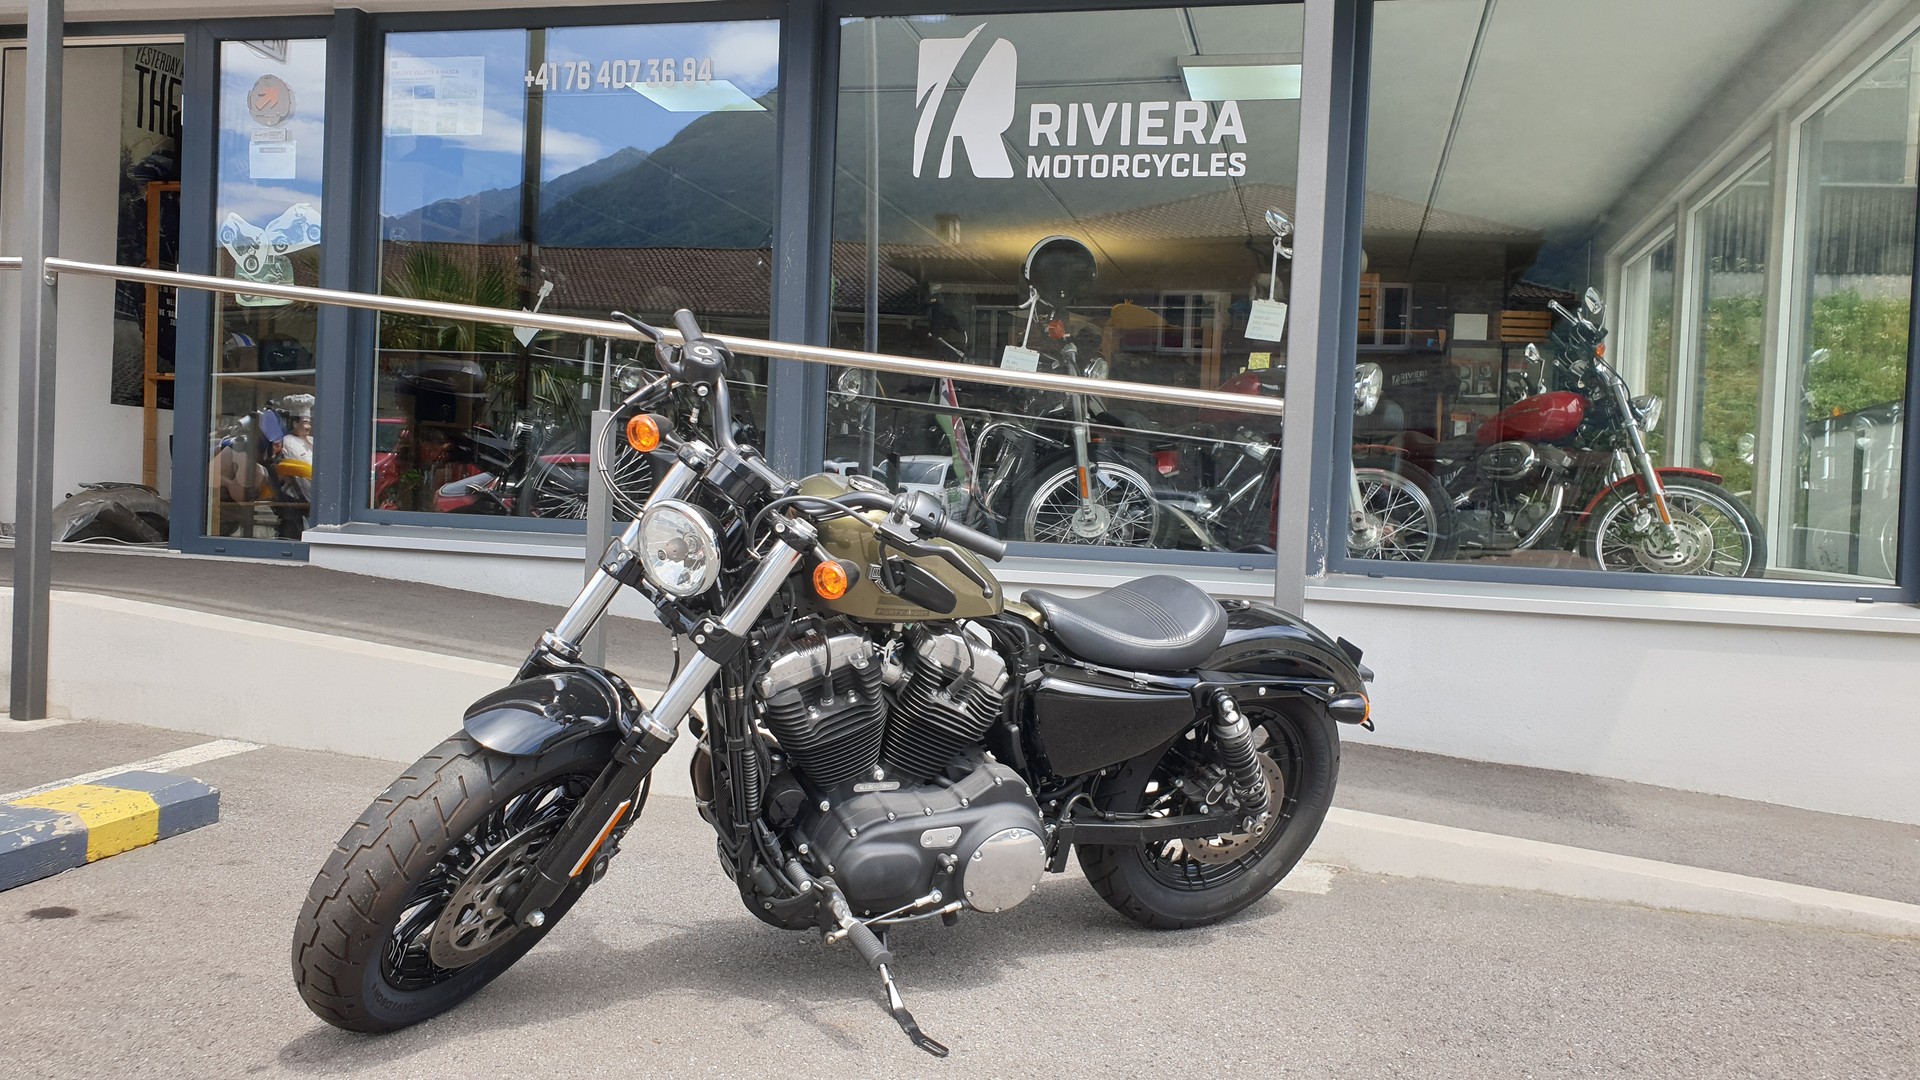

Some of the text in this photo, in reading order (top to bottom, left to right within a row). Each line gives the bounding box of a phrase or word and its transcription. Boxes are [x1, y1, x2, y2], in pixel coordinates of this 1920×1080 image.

[136, 46, 180, 76] YESTERDAY
[525, 57, 712, 91] +41 76 407 36 94
[1028, 101, 1247, 147] RIVIERA
[1026, 152, 1247, 179] MOTORCYCLES
